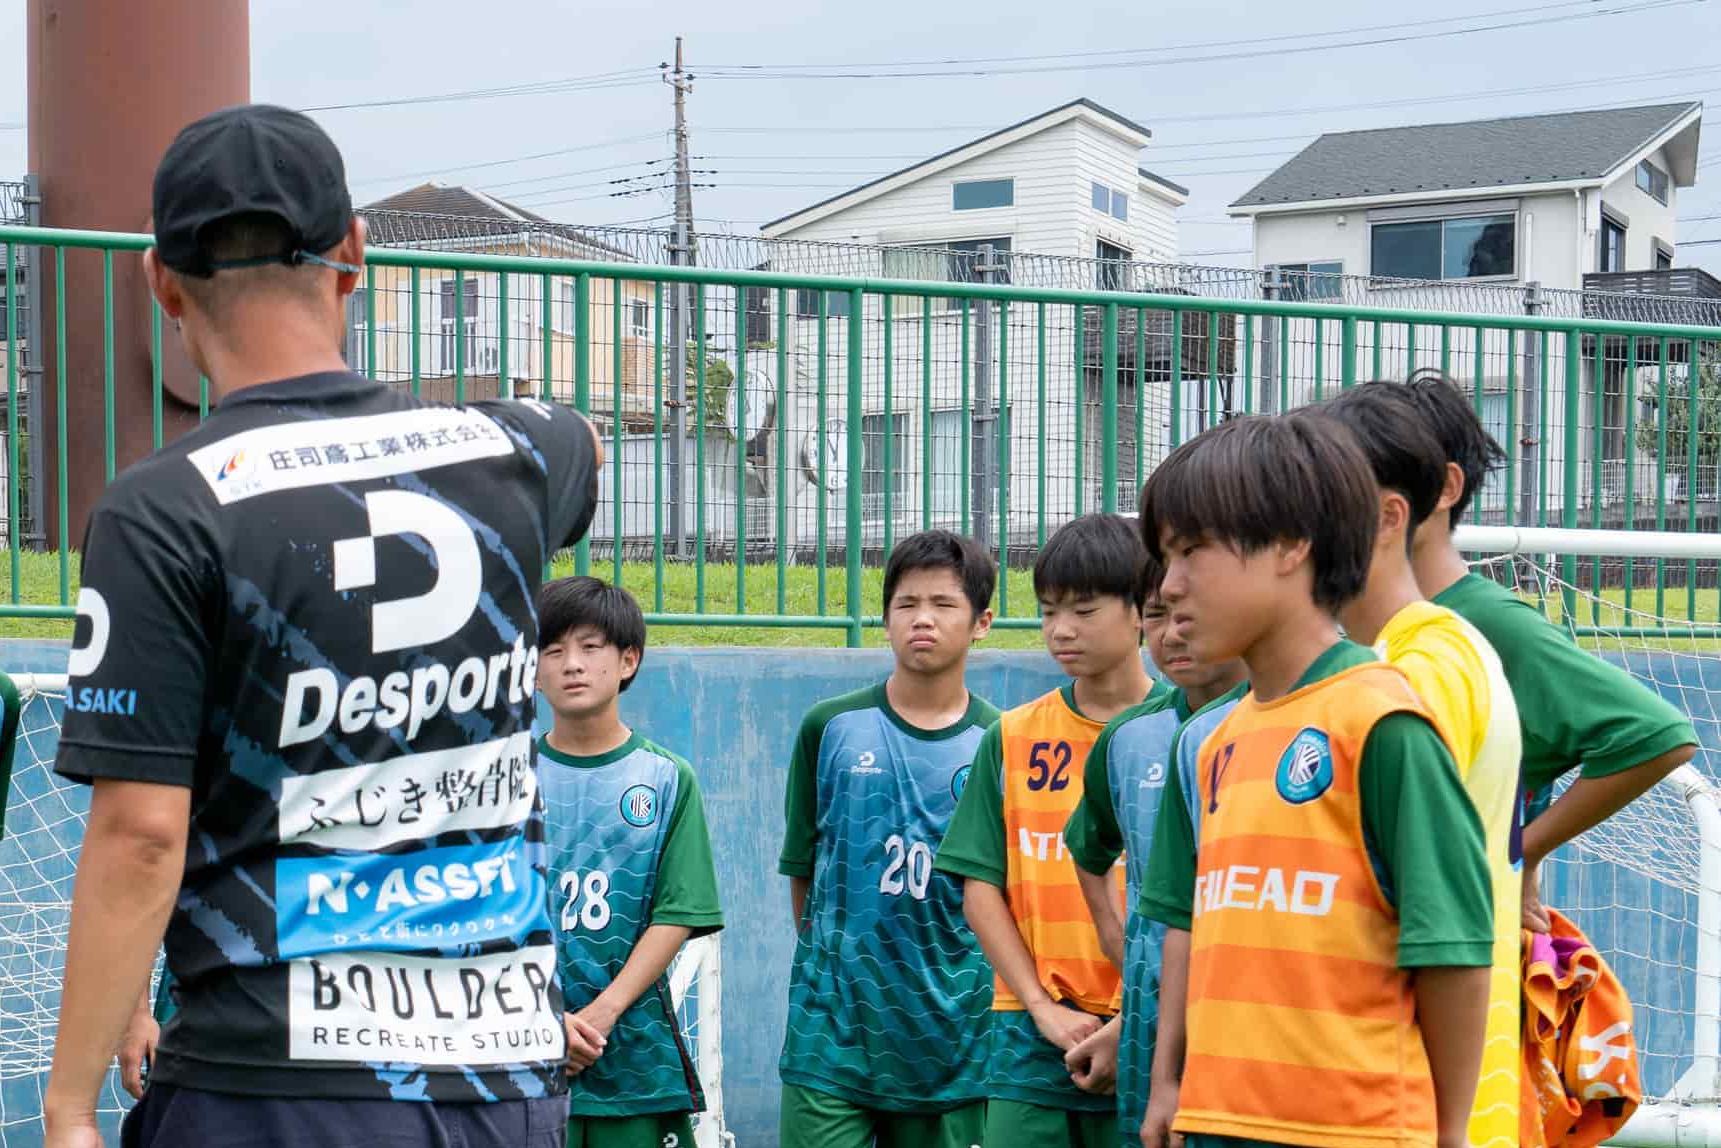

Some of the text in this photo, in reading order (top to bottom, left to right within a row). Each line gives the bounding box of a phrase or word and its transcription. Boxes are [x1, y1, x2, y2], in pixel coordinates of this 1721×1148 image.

[279, 632, 539, 748] Desporte
[1028, 741, 1072, 792] 52
[880, 834, 933, 900] 20
[559, 870, 611, 932] 28
[310, 959, 547, 1020] BOULDER
[313, 1026, 554, 1052] RECREATE STUDIO
